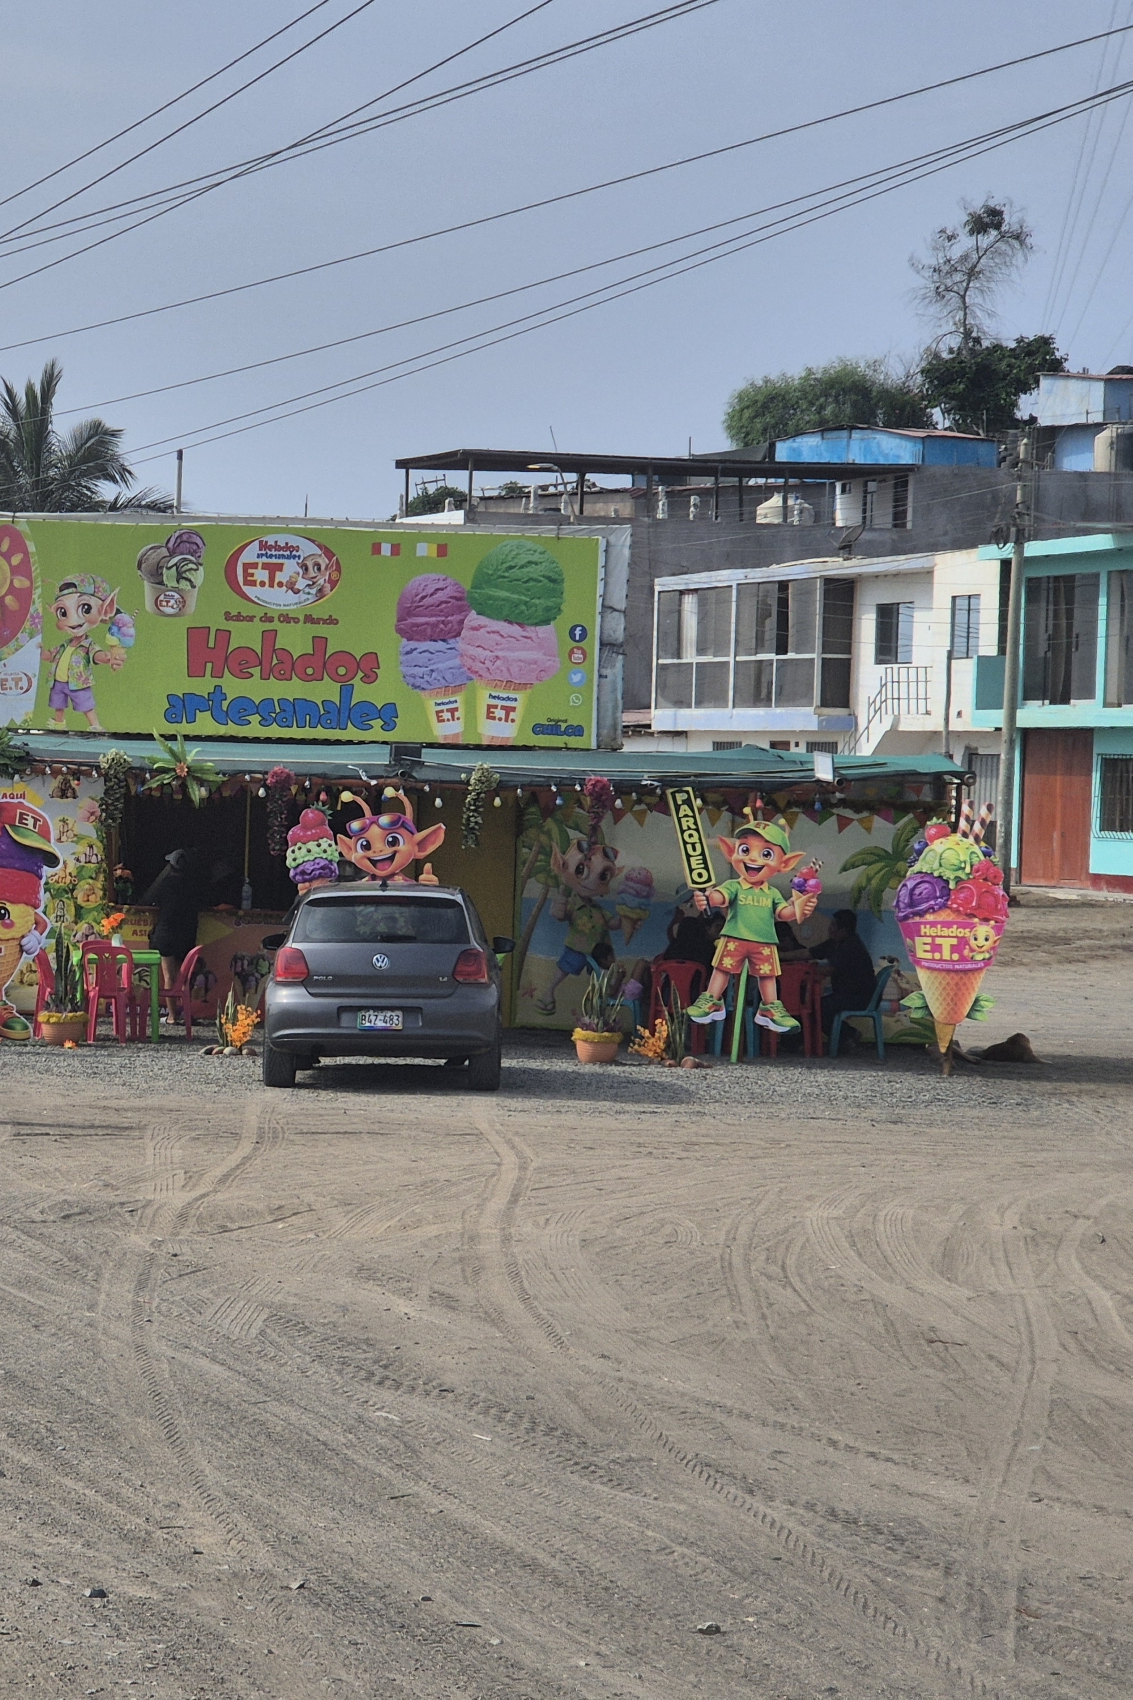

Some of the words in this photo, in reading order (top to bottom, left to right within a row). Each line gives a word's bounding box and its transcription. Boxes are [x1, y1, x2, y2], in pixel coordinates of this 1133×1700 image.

[259, 540, 300, 552] Helados
[242, 562, 285, 589] E.T.
[254, 595, 282, 607] PRODUCTOS
[224, 611, 256, 623] Sabor
[259, 612, 274, 623] de
[278, 613, 300, 624] Otro
[303, 614, 339, 625] Mundo
[186, 626, 381, 684] Helados
[0, 677, 24, 691] E.T.
[488, 692, 518, 703] helados
[163, 684, 399, 732] artesanales
[485, 703, 517, 724] E.T.
[435, 707, 461, 724] E.T.
[532, 723, 584, 737] CHILCA
[17, 810, 42, 830] ET
[754, 821, 770, 831] ET
[675, 792, 709, 883] PARQUEO
[739, 894, 772, 908] SALIM
[920, 924, 971, 937] Helados
[914, 936, 960, 960] E.T.
[921, 961, 953, 969] PRODUCTOS
[955, 961, 984, 969] NATURALES
